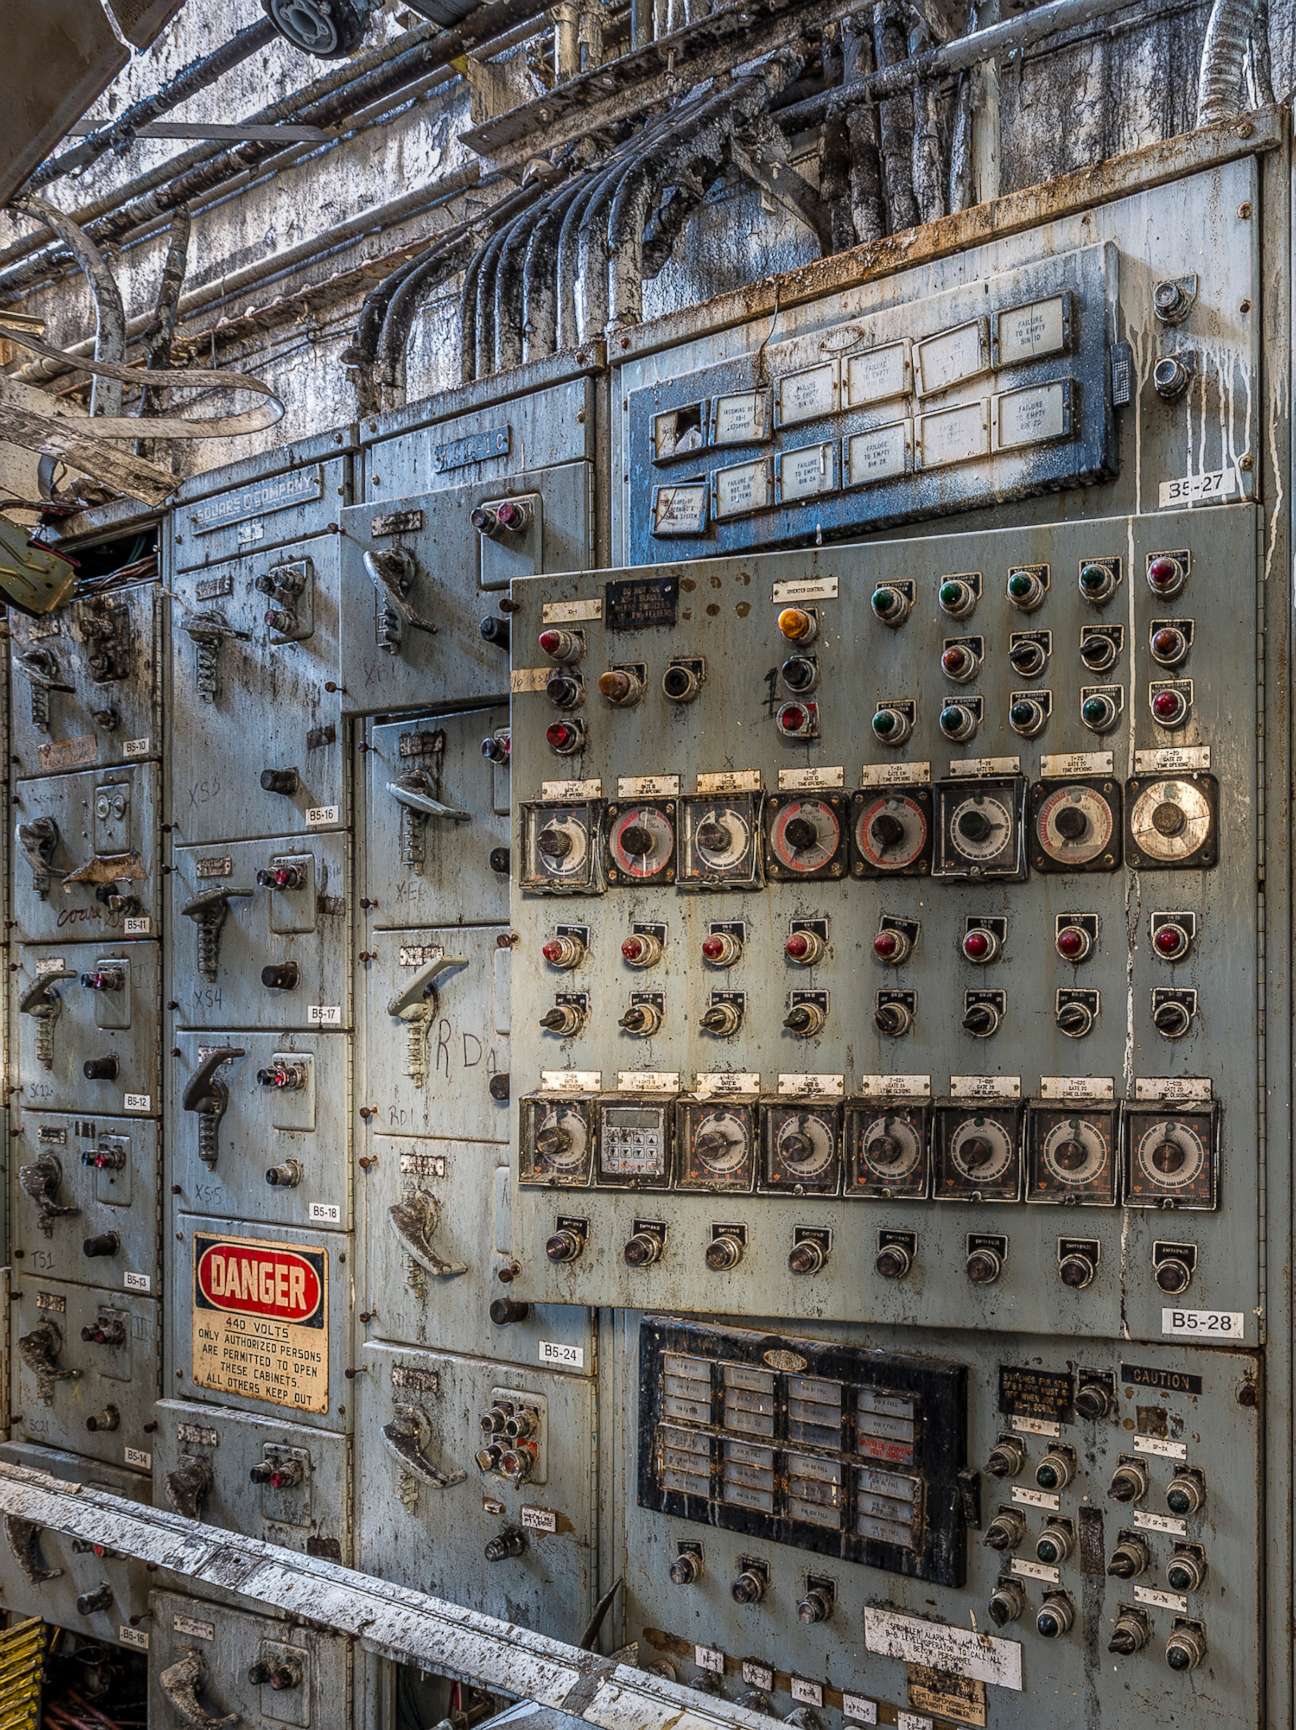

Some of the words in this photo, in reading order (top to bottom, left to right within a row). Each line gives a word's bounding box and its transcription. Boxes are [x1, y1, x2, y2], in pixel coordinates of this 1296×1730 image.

[797, 459, 817, 468] FAILURE
[253, 477, 311, 507] COMPANY
[310, 808, 334, 820] B5-16
[312, 1008, 336, 1020] B5-17
[128, 1096, 147, 1107] B5-12
[313, 1204, 337, 1219] B5-18
[210, 1254, 308, 1311] DANGER
[226, 1317, 246, 1330] 440
[253, 1322, 289, 1338] VOLTS
[1172, 1312, 1232, 1331] B5-28
[199, 1329, 219, 1342] ONLY
[225, 1334, 276, 1354] AUTHORIZED
[280, 1345, 321, 1363] PERSONS
[544, 1344, 577, 1361] B5-24
[203, 1344, 218, 1356] ARE
[224, 1349, 271, 1367] PERMITTED
[277, 1359, 288, 1371] TO
[294, 1363, 318, 1377] OPEN
[221, 1361, 248, 1377] THESE
[253, 1369, 300, 1388] CABINETS.
[1133, 1369, 1190, 1390] CAUTION
[206, 1371, 222, 1384] ALL
[228, 1377, 260, 1394] OTHERS
[266, 1386, 288, 1401] KEEP
[295, 1392, 313, 1406] OUT
[971, 1650, 986, 1660] CALL
[990, 1655, 1002, 1664] ALL
